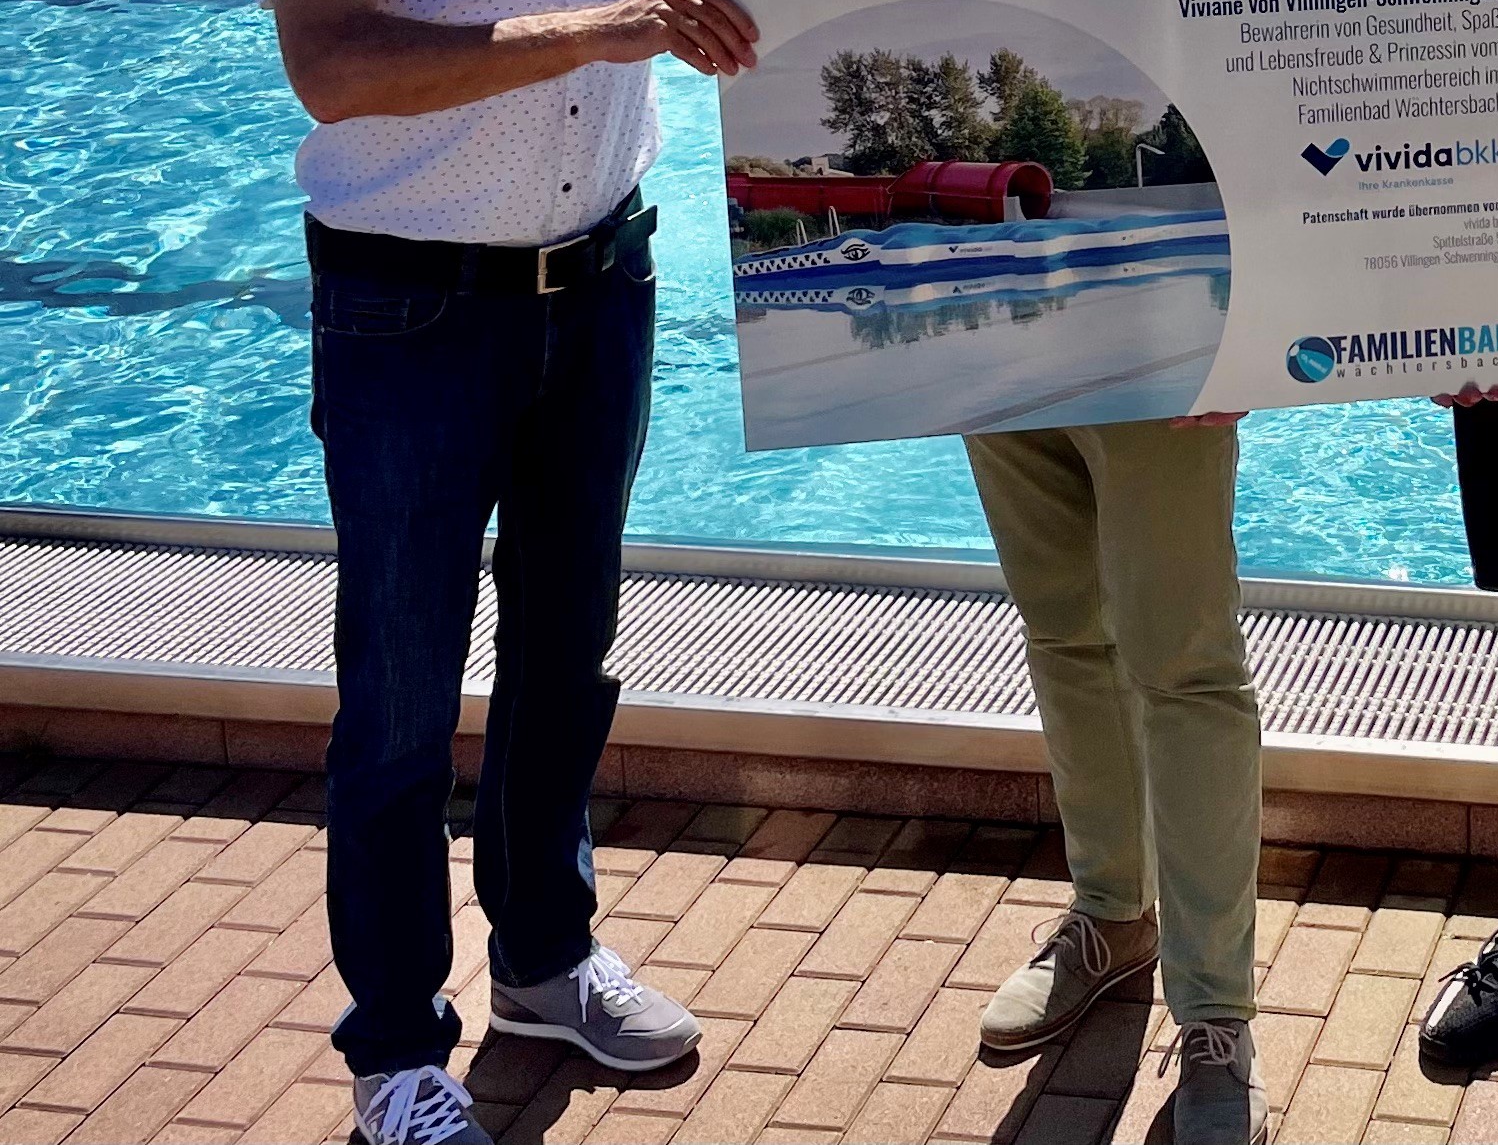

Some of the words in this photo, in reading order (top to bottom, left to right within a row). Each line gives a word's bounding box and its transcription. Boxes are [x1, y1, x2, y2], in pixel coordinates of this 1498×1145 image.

[1240, 19, 1330, 44] Bewahrerin
[1334, 20, 1361, 38] von
[1366, 11, 1457, 36] Gesundheit,
[1226, 50, 1254, 73] und
[1259, 45, 1364, 71] Lebensfreude
[1368, 43, 1383, 64] &
[1387, 39, 1466, 63] Prinzessin
[1292, 65, 1480, 97] Nichtschwimmerbereich
[1298, 98, 1390, 125] Familienbad
[1358, 180, 1380, 191] Ihre
[1382, 176, 1454, 189] Krankenkasse
[1302, 208, 1369, 225] Patenschaft
[1371, 205, 1406, 220] wurde
[1408, 203, 1480, 217] übernommen
[1463, 216, 1491, 230] vivida
[1363, 255, 1398, 270] 78056
